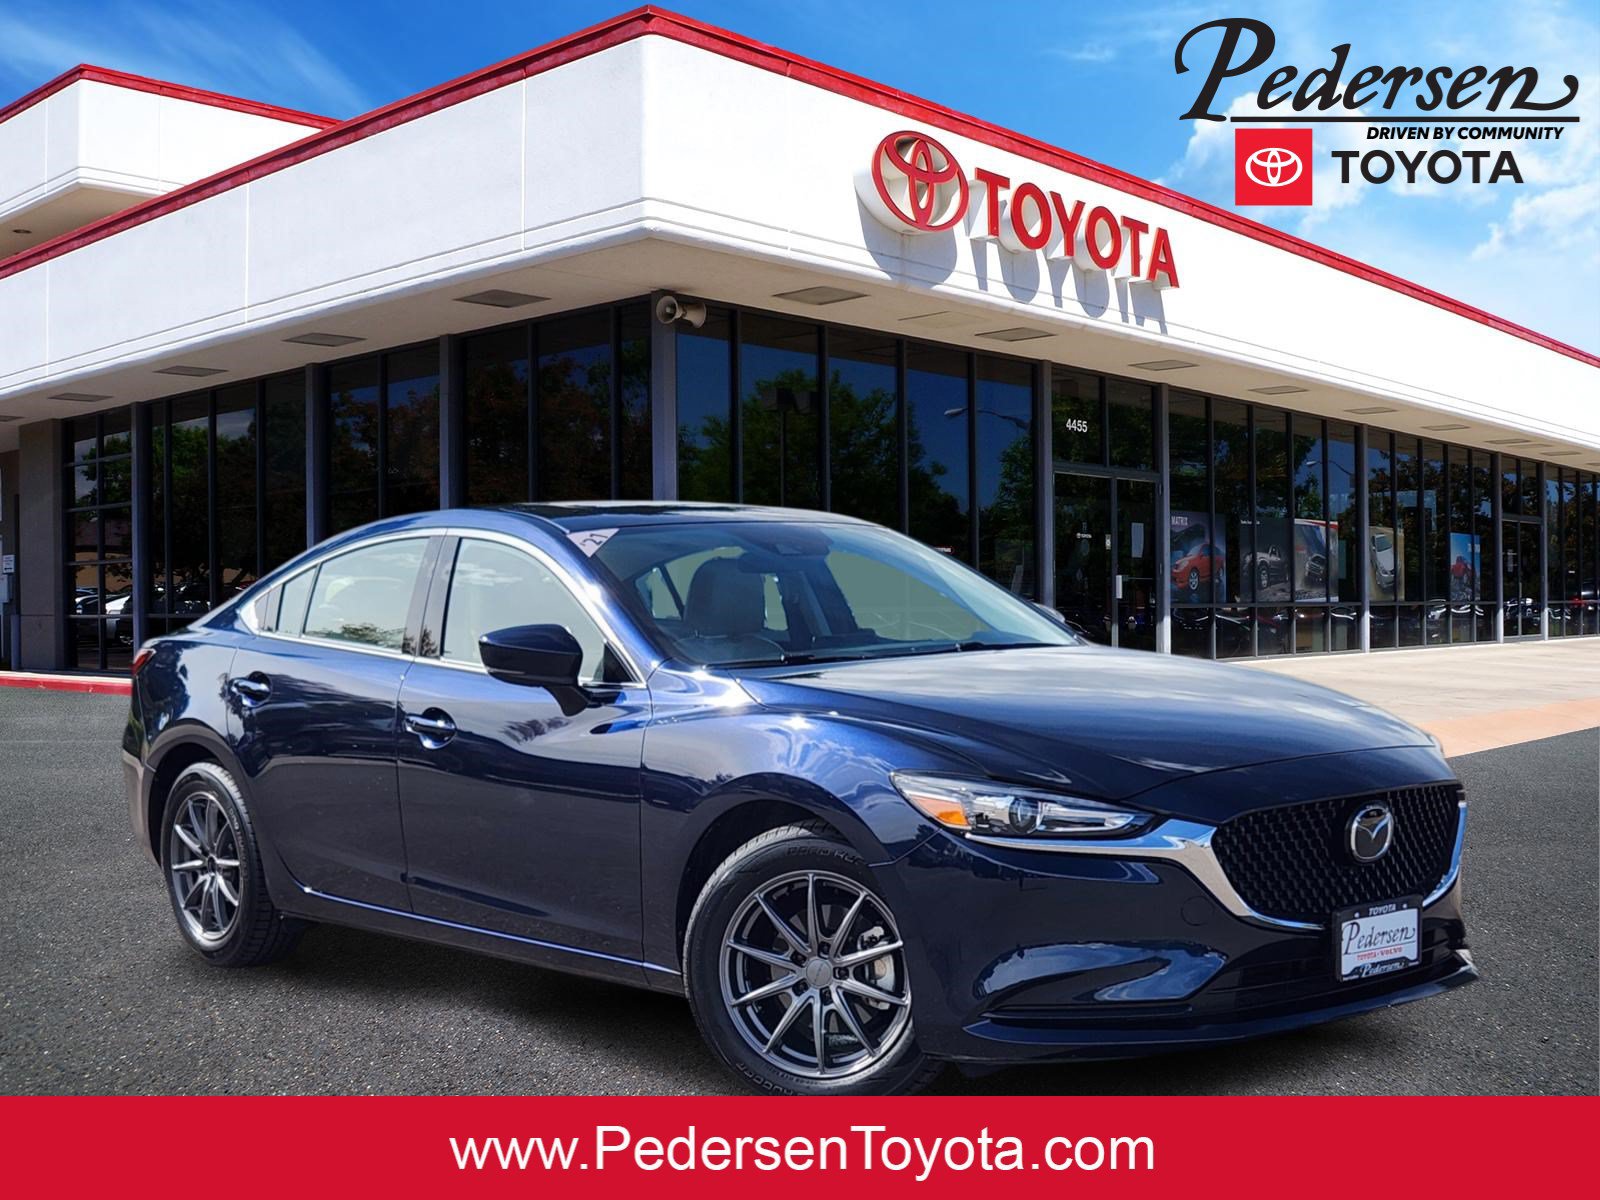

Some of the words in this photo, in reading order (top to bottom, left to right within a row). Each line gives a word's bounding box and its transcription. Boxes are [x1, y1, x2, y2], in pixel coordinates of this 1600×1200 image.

[974, 167, 1180, 289] TOYOTA
[1065, 418, 1088, 433] 4455
[1369, 903, 1397, 916] TOYOTA
[1342, 921, 1416, 955] Pedersen
